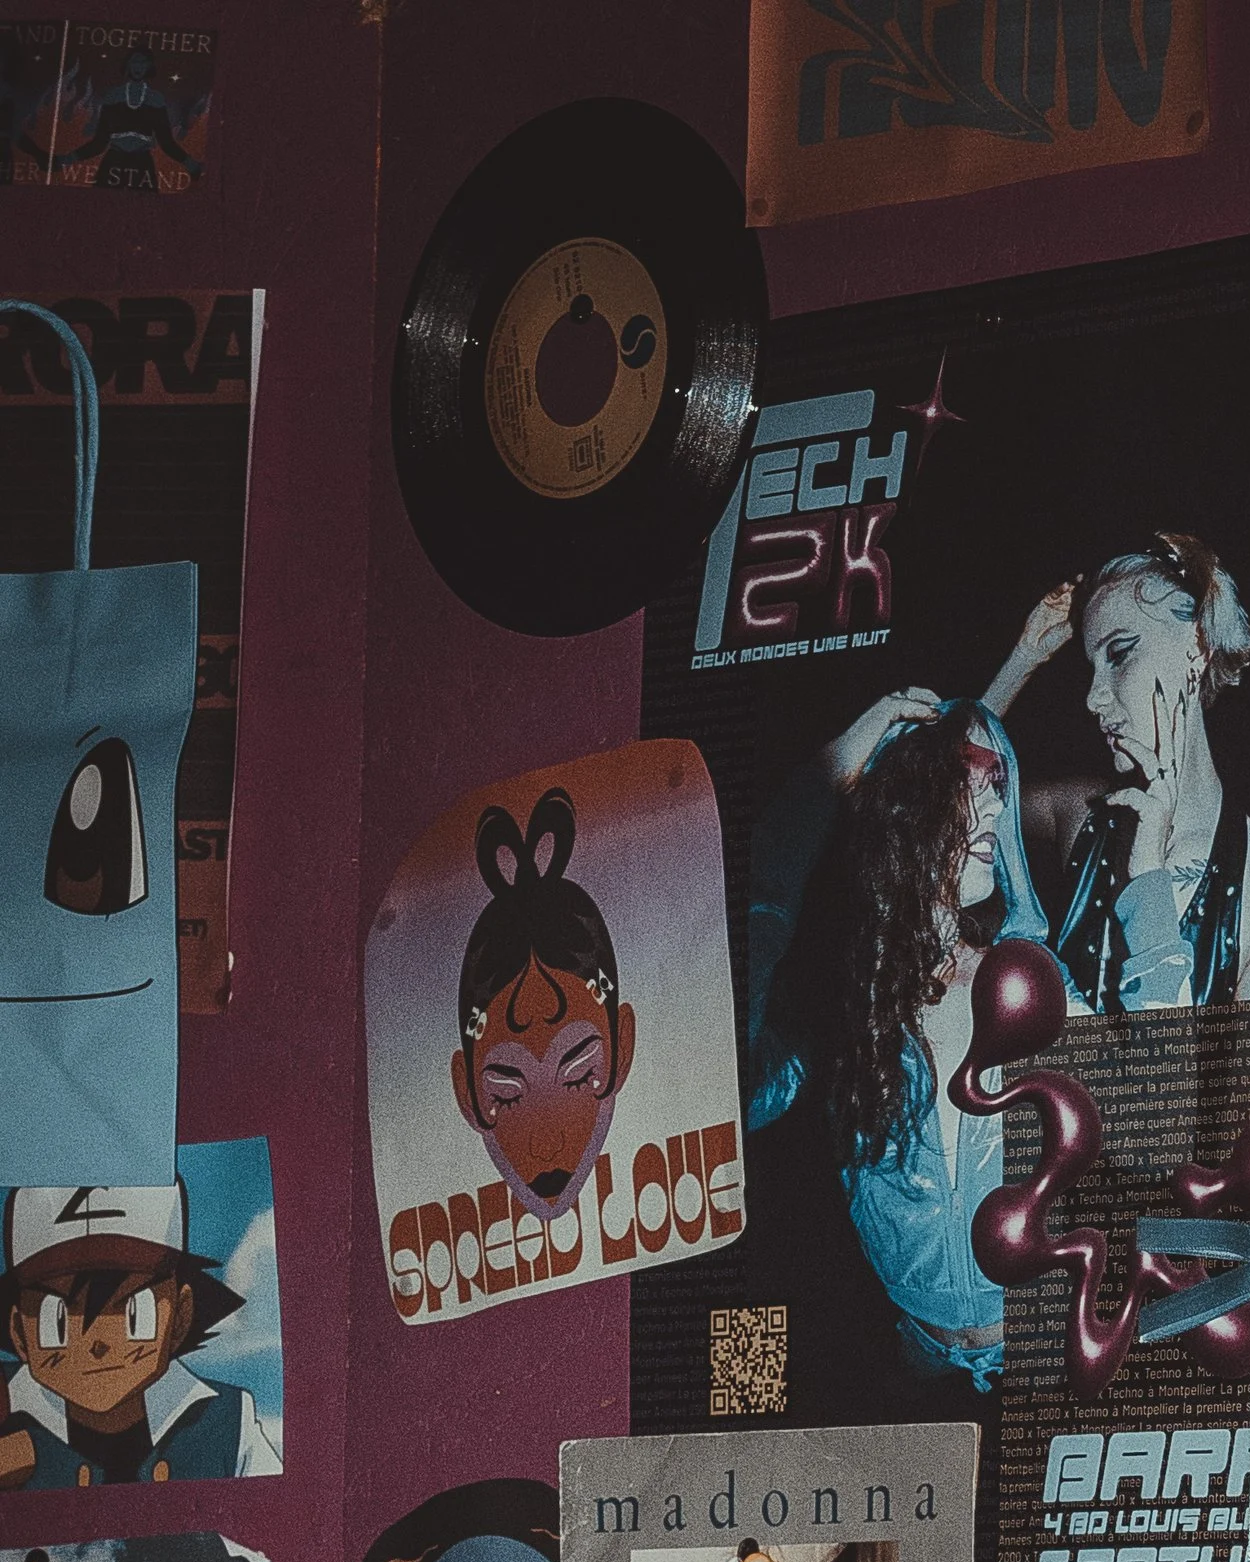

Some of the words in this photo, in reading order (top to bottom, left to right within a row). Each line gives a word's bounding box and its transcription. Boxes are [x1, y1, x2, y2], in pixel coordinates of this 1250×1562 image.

[76, 26, 212, 54] TOGETHER
[62, 164, 99, 184] WE
[107, 167, 192, 190] STAND
[693, 388, 907, 652] TECH
[735, 503, 897, 640] 2K
[691, 649, 737, 670] DEUX
[740, 640, 810, 664] MONDES
[813, 635, 848, 654] UNE
[851, 629, 891, 648] NUIT
[1066, 1031, 1102, 1045] Années
[1105, 1027, 1131, 1040] 2000
[1145, 1023, 1182, 1038] Techno
[1196, 1016, 1248, 1034] Montpellier
[1033, 1050, 1068, 1065] Années
[1073, 1048, 1098, 1061] 2000
[1112, 1045, 1149, 1060] Techno
[1164, 1038, 1219, 1057] Montpellier
[1077, 1065, 1111, 1080] Techno
[1125, 1058, 1182, 1078] Montpellier
[1200, 1053, 1243, 1073] première
[1159, 1074, 1205, 1094] première
[1208, 1073, 1237, 1087] soirée
[1003, 1109, 1038, 1122] Techno
[1119, 1097, 1164, 1117] première
[1167, 1094, 1198, 1110] soirée
[1201, 1094, 1227, 1110] queer
[1114, 1118, 1144, 1132] soirée
[1147, 1116, 1175, 1131] queer
[1177, 1112, 1212, 1128] Années
[1214, 1109, 1238, 1123] 2000
[1124, 1132, 1158, 1147] Années
[1161, 1131, 1186, 1145] 2000
[1196, 1128, 1229, 1143] Techno
[1109, 1154, 1134, 1168] 2000
[1148, 1150, 1182, 1165] Techno
[1116, 1171, 1150, 1185] Techno
[1079, 1190, 1113, 1205] Techno
[1074, 1210, 1105, 1226] soirée
[1145, 1204, 1181, 1220] Années
[389, 1180, 583, 1318] SPREAD
[1145, 1366, 1182, 1381] Techno
[1108, 1384, 1143, 1400] Techno
[1158, 1383, 1216, 1402] Montpellier
[1073, 1404, 1108, 1420] Techno
[1122, 1400, 1179, 1420] Montpellier
[1197, 1397, 1242, 1417] première
[594, 1470, 938, 1533] madonna
[1044, 1512, 1062, 1535] 4
[1069, 1511, 1109, 1535] BD
[1115, 1508, 1200, 1533] LOUIS
